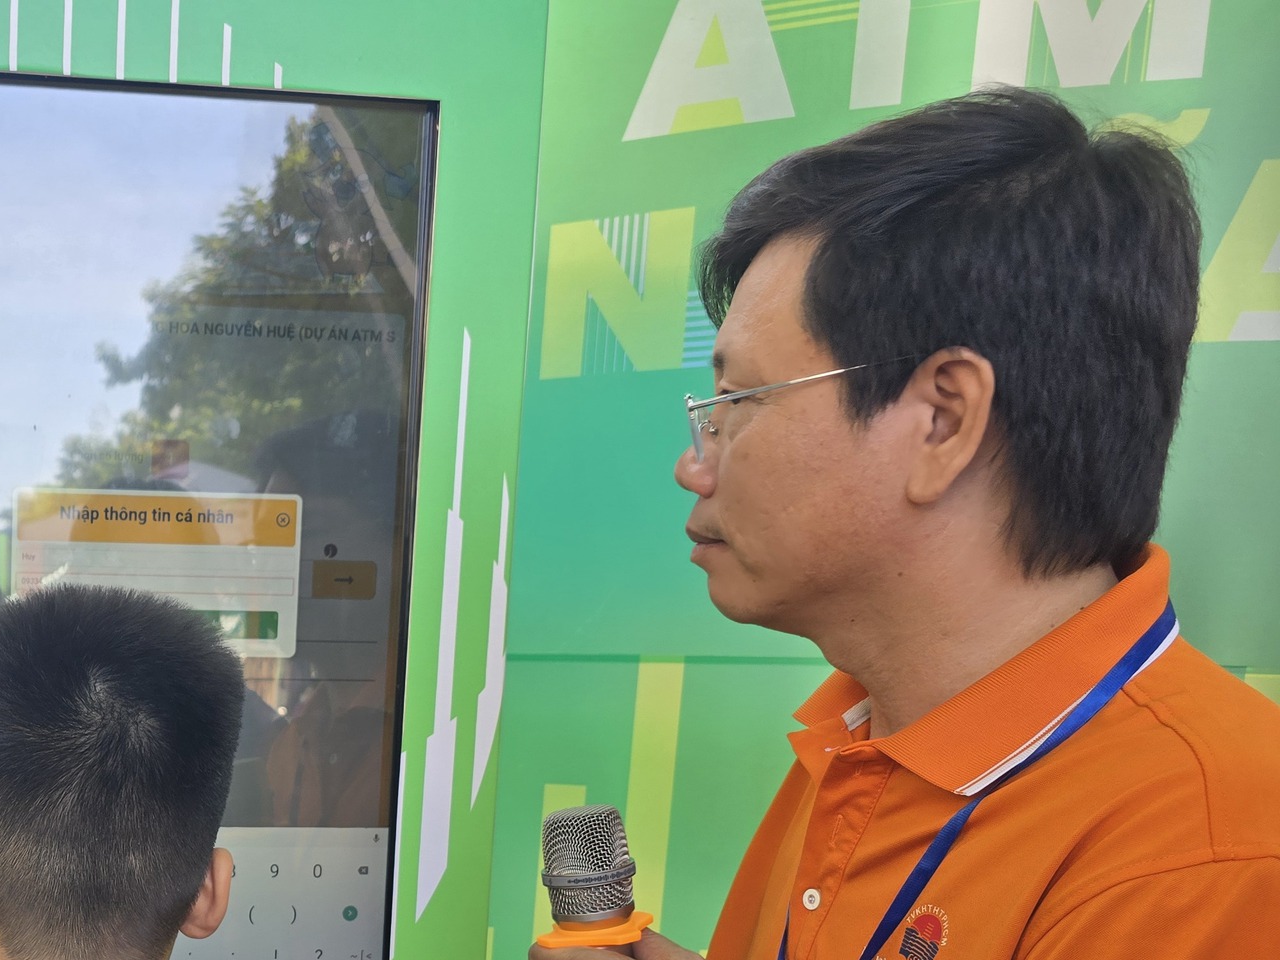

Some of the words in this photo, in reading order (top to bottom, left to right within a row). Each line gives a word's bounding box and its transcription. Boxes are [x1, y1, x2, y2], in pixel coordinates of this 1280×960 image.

[351, 330, 382, 342] ATM
[60, 506, 99, 524] Nhập
[104, 506, 148, 525] thông
[151, 507, 171, 522] tin
[175, 508, 193, 522] cá
[197, 509, 234, 524] nhân
[270, 863, 280, 878] 9
